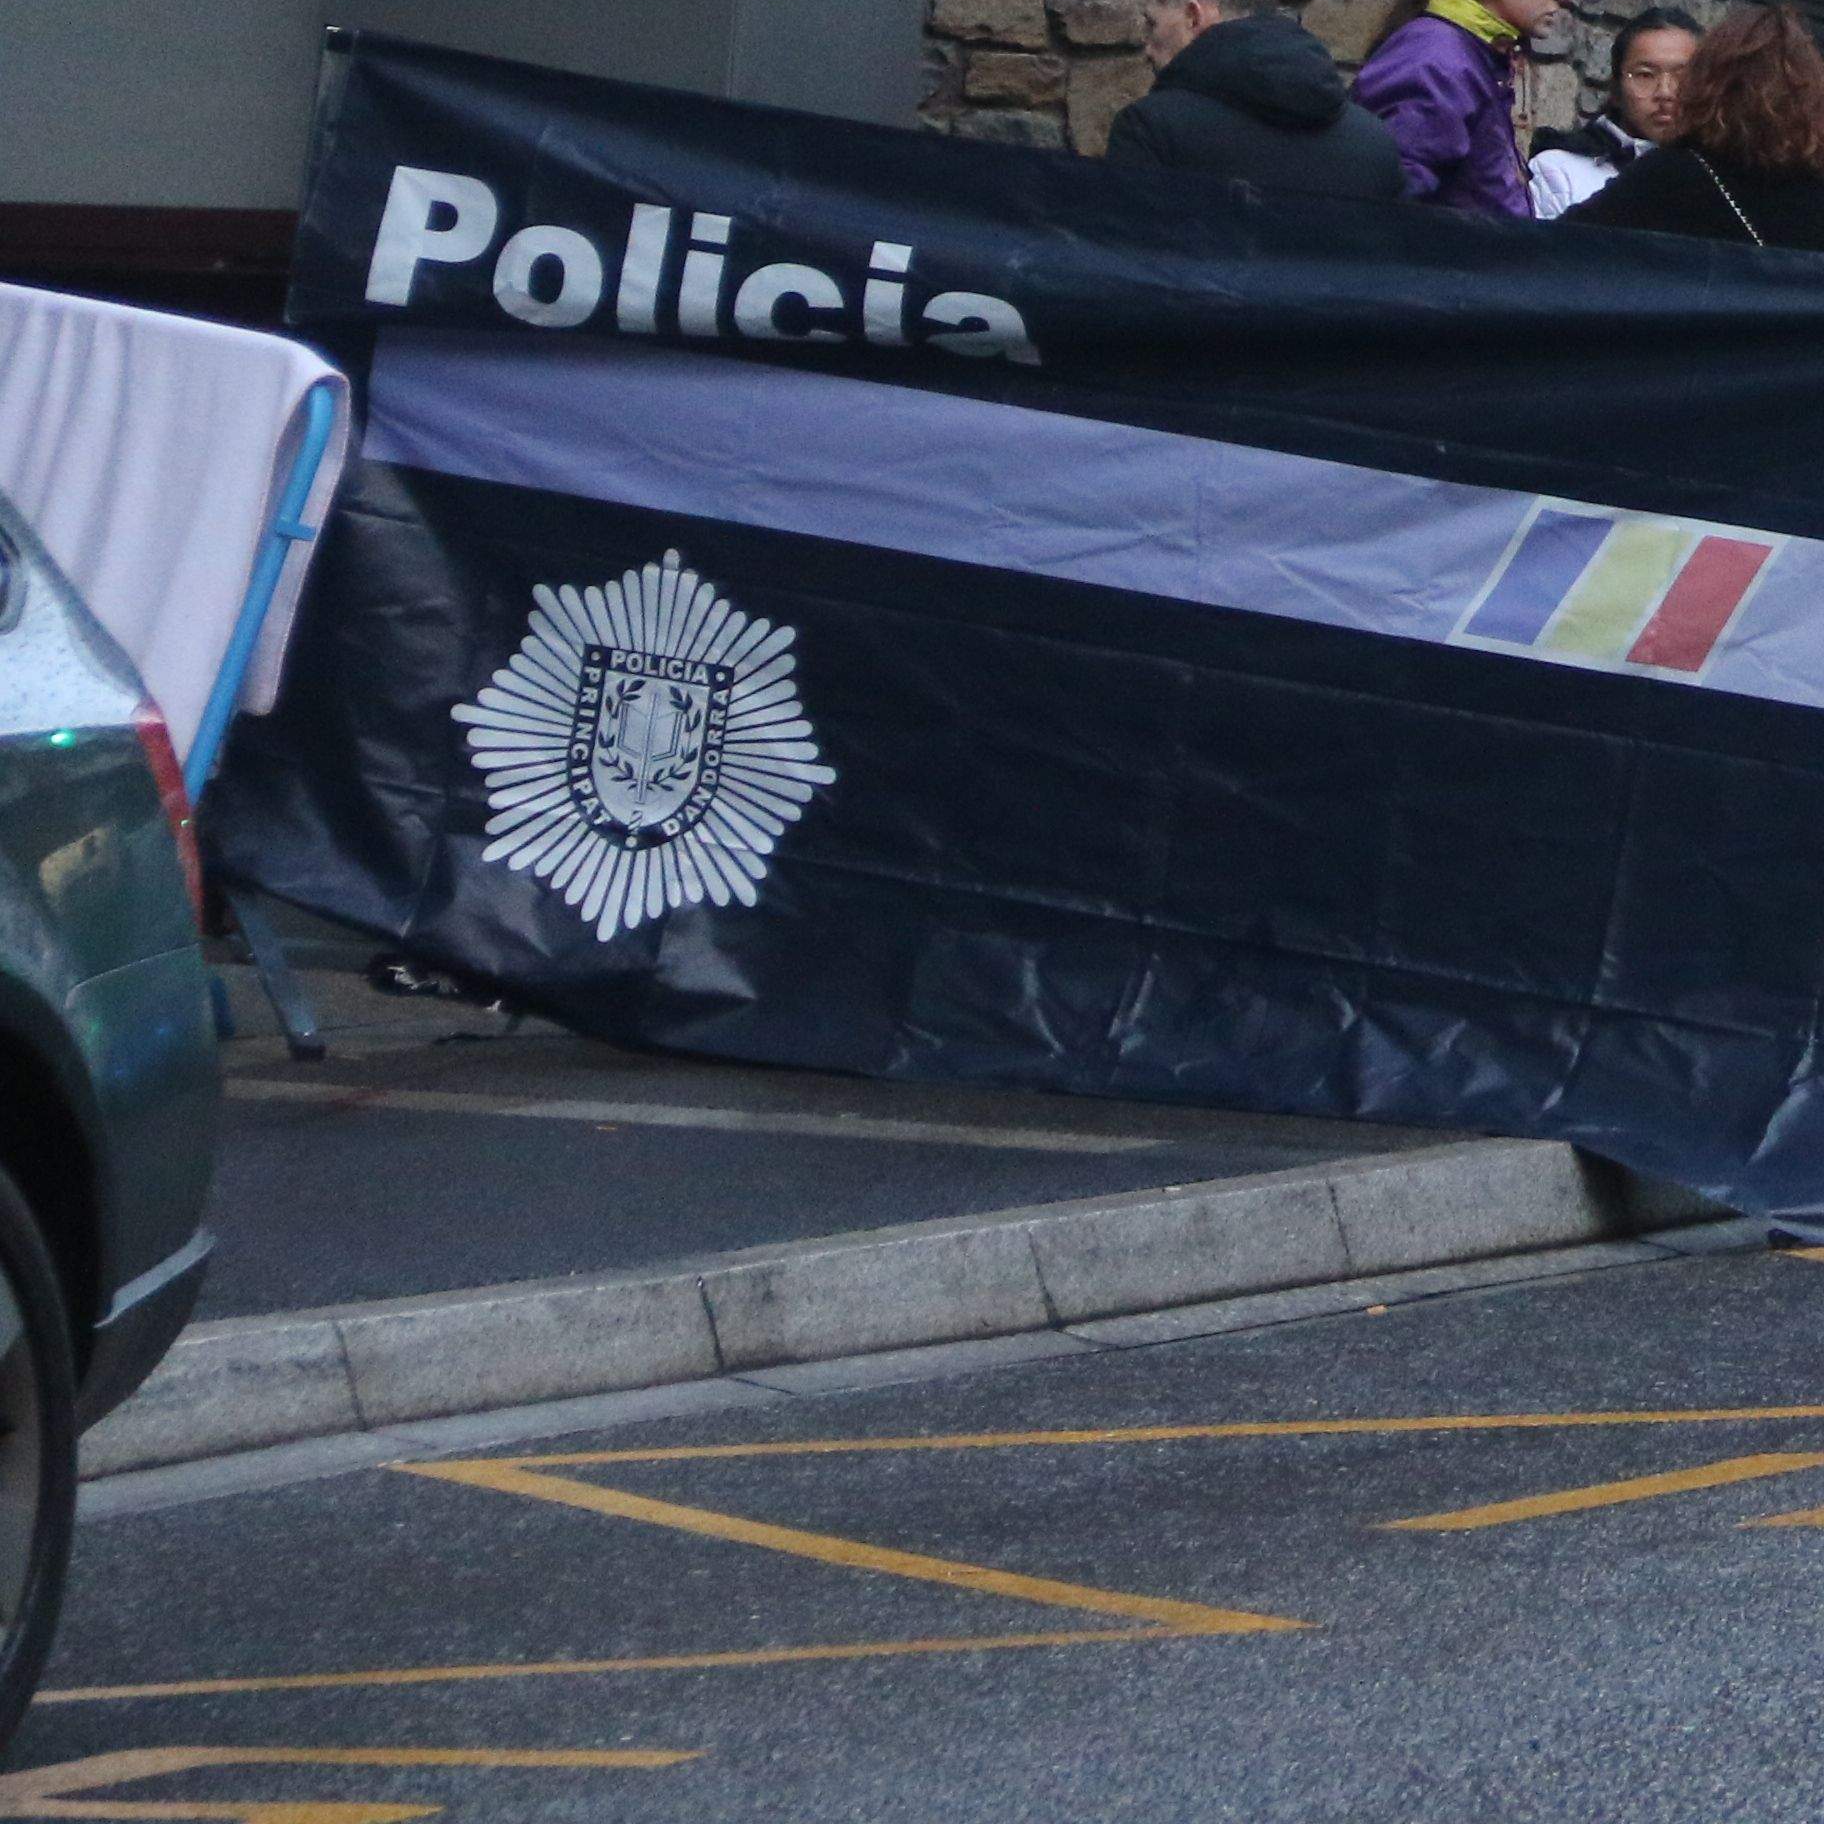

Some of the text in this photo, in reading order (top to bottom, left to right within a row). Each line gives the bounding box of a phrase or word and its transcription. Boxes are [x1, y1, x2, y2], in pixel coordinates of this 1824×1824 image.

[365, 165, 1042, 366] Policia
[611, 648, 710, 684] POLICIA
[570, 666, 612, 825] PRINCIPAT
[661, 688, 731, 837] D'ANDORRA
